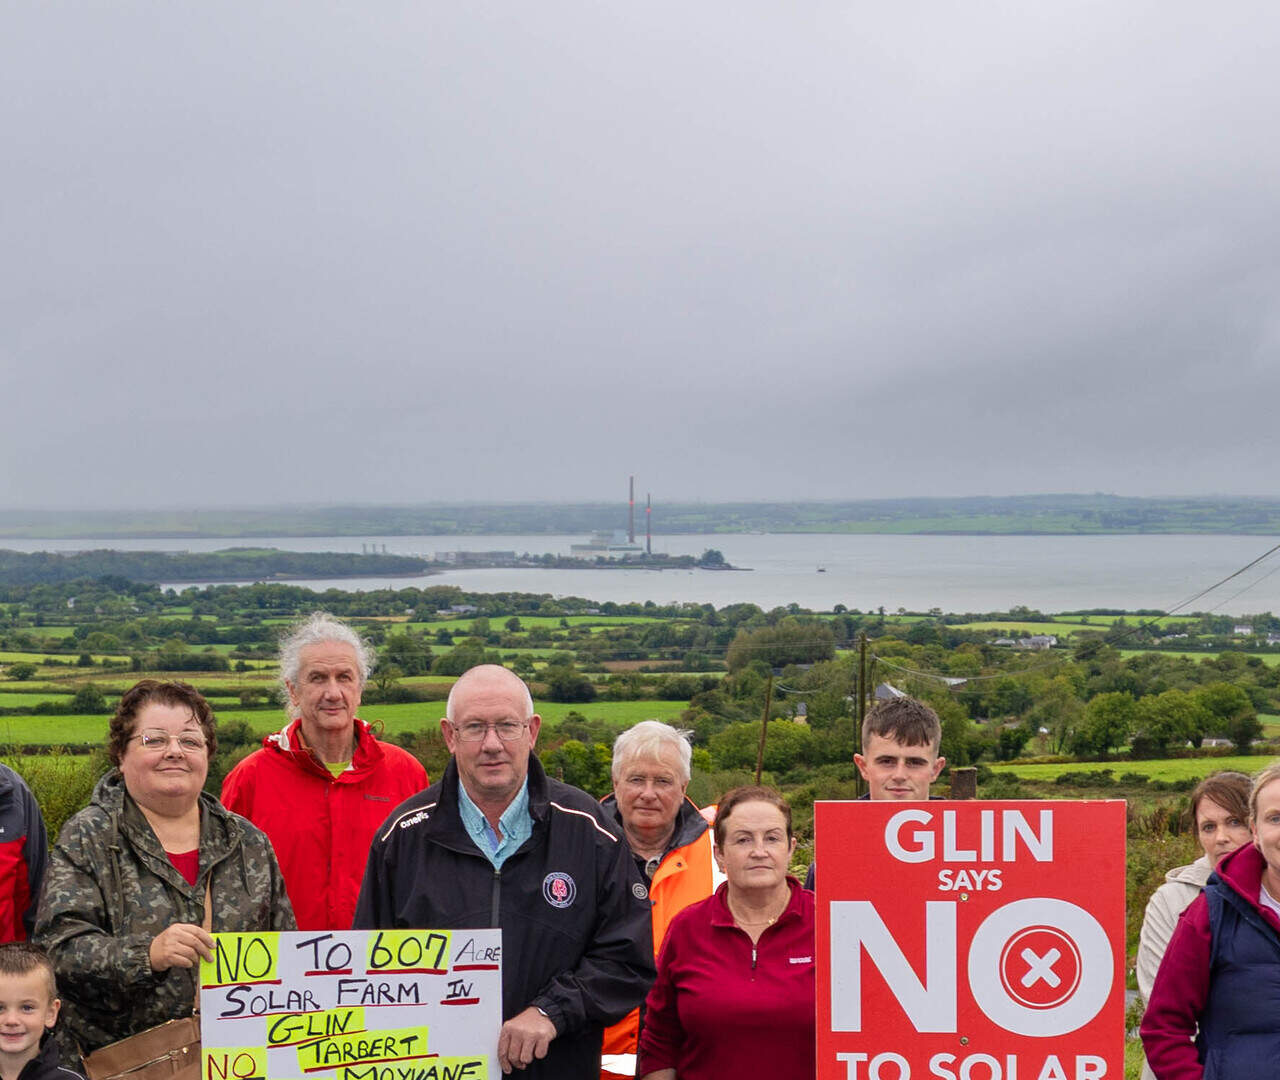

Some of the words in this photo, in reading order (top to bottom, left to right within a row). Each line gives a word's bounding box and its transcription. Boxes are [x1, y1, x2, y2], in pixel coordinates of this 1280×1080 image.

[884, 809, 1053, 863] GLIN
[938, 870, 1002, 891] SAYS
[216, 937, 272, 984] NO
[370, 932, 447, 970] 607
[830, 897, 1114, 1037] NO
[220, 986, 320, 1017] SOLAR
[337, 979, 419, 1004] FARM
[447, 979, 472, 998] IN
[268, 1011, 352, 1043] GLIN
[208, 1053, 256, 1080] NO
[298, 1036, 418, 1063] TARBERT
